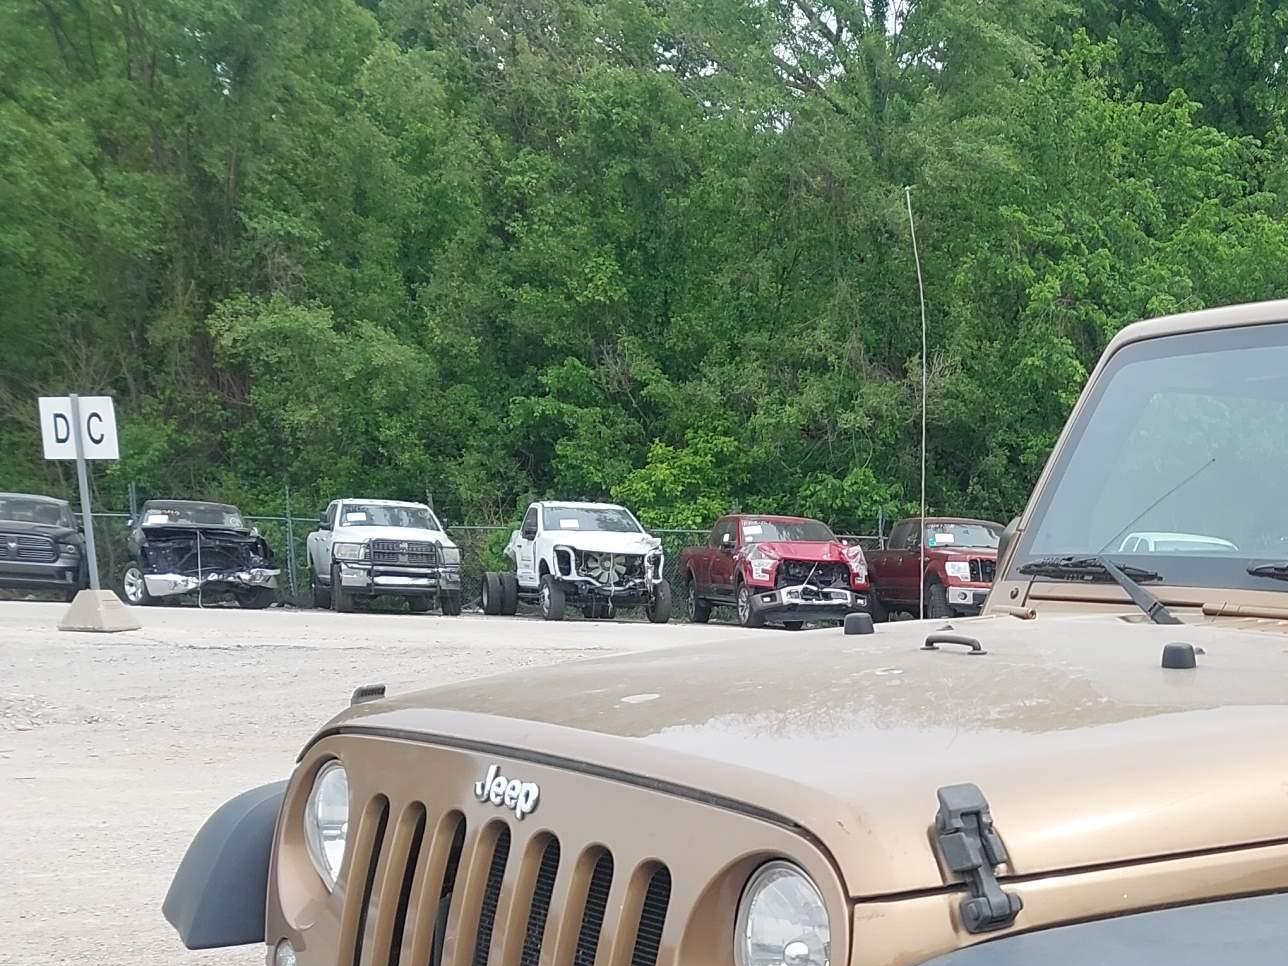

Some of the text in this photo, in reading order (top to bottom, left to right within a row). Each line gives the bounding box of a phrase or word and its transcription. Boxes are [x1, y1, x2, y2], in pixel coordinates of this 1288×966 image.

[53, 411, 104, 446] D C
[474, 764, 541, 821] Jeep
